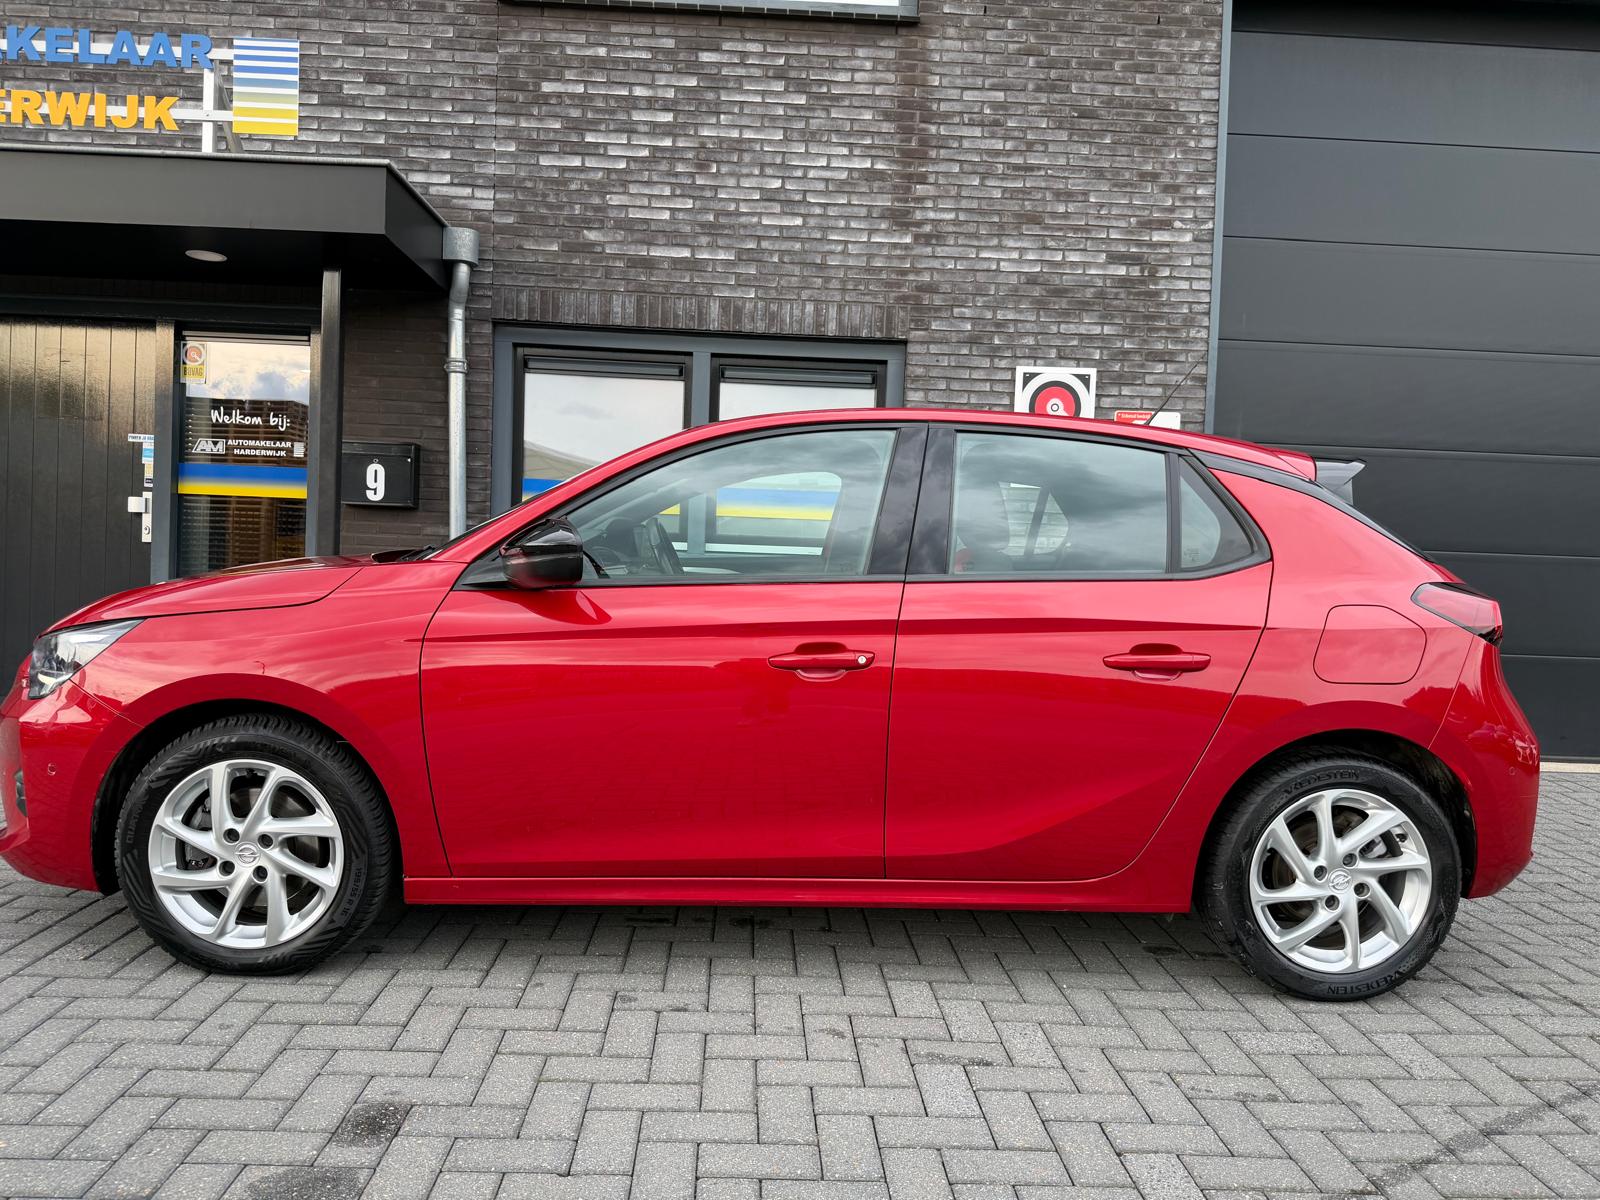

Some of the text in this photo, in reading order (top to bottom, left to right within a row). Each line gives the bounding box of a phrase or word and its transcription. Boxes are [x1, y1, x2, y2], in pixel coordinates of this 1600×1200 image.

[0, 24, 214, 69] KELAAR
[0, 88, 180, 131] RWIJK
[184, 367, 203, 377] BOVAG
[211, 406, 291, 431] Welkom bij:
[195, 439, 224, 452] AM
[227, 439, 292, 448] AUTOMAKELAAR
[233, 448, 287, 457] HARDERWIJK
[365, 463, 385, 501] 9
